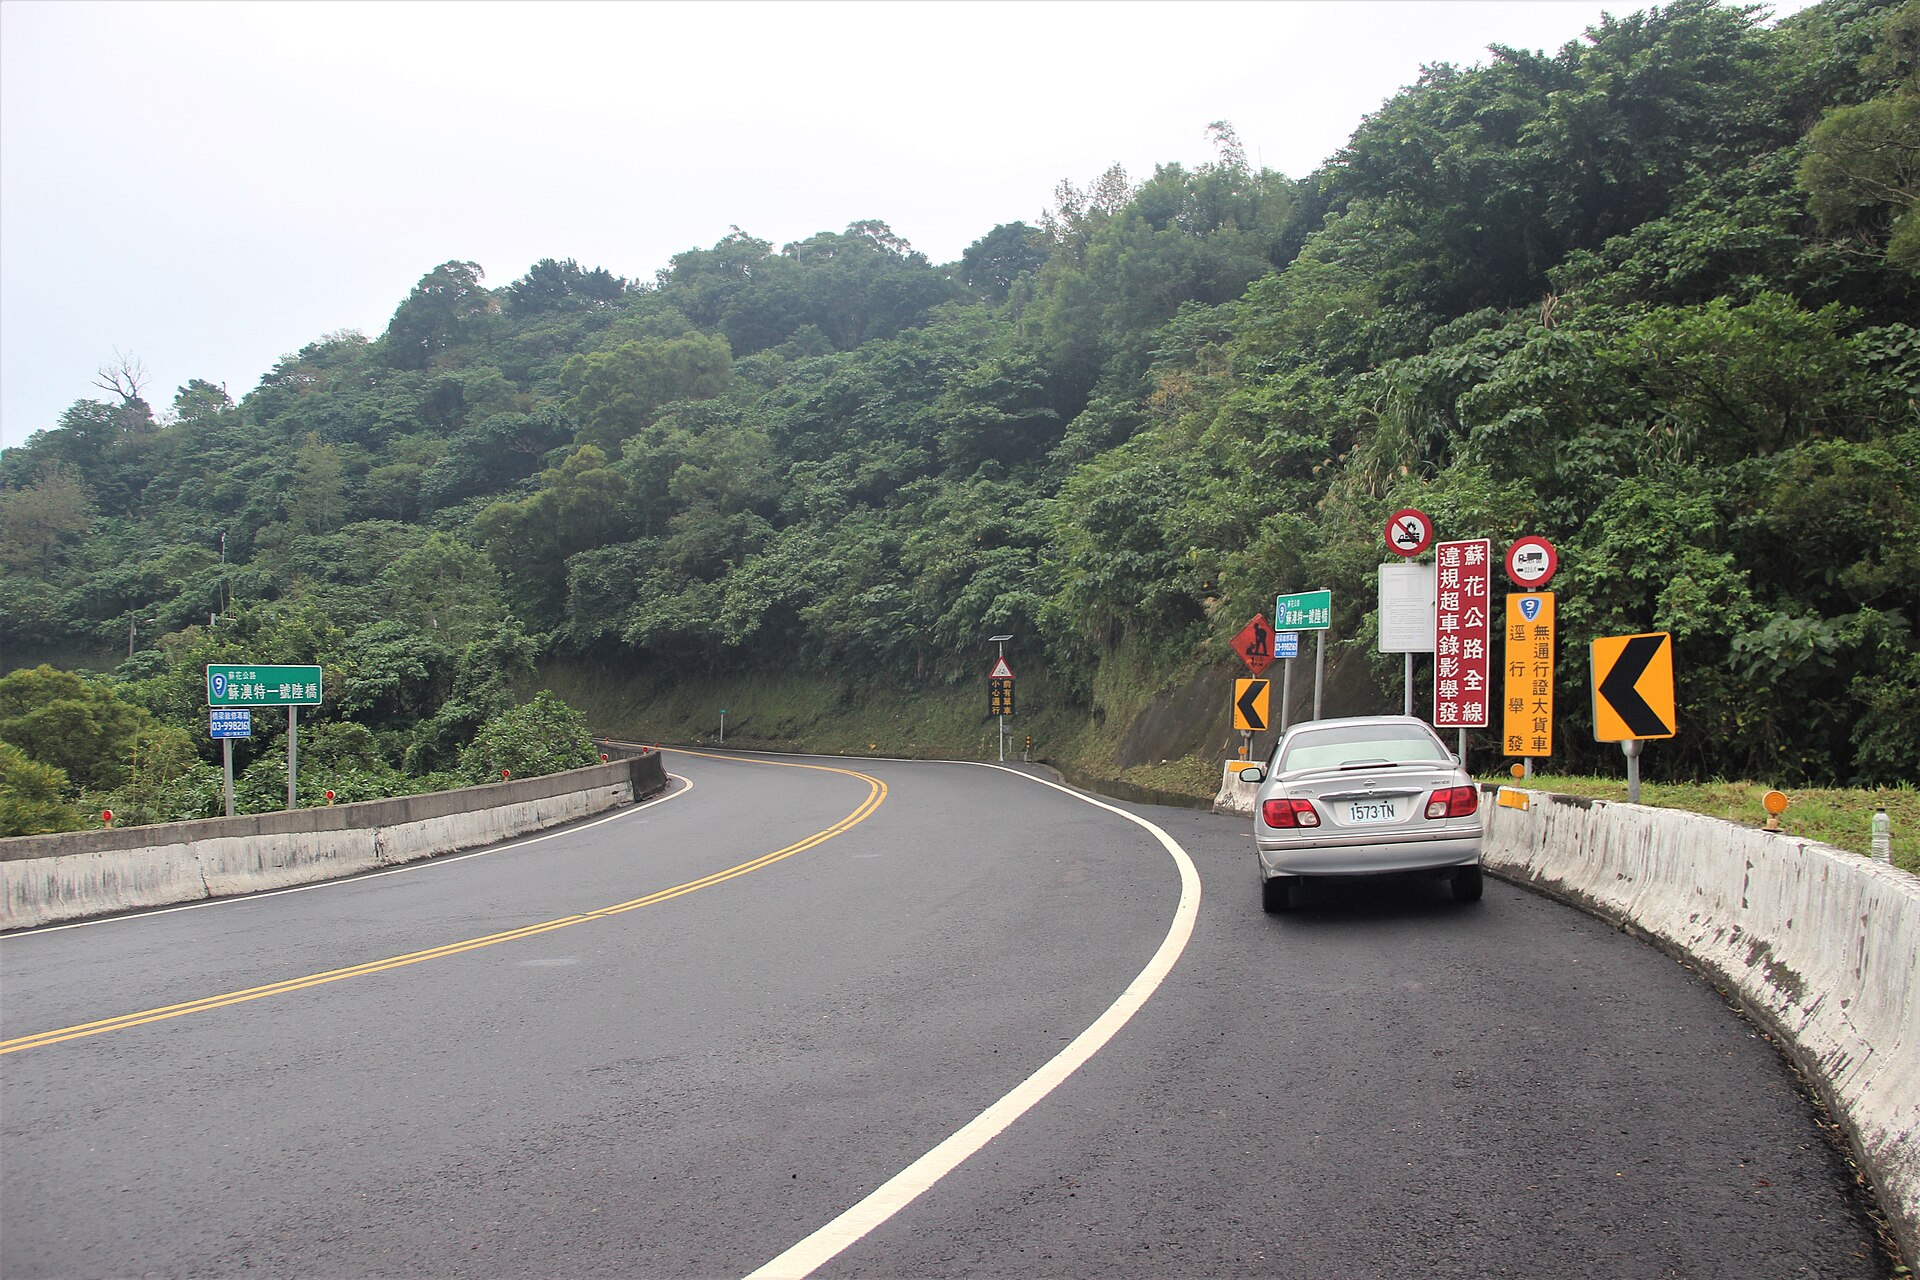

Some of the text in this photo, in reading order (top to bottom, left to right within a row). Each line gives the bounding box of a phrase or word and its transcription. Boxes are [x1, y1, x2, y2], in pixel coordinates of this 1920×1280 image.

[1438, 547, 1461, 723] 違規超車錄影舉發
[1462, 544, 1485, 723] 蘇花公路全線
[1526, 601, 1534, 611] 9
[216, 678, 222, 689] 9
[228, 683, 317, 699] 蘇澳特一號陸橋
[1508, 625, 1526, 752] 逕行舉發
[1531, 624, 1550, 752] 無通行證大貨車
